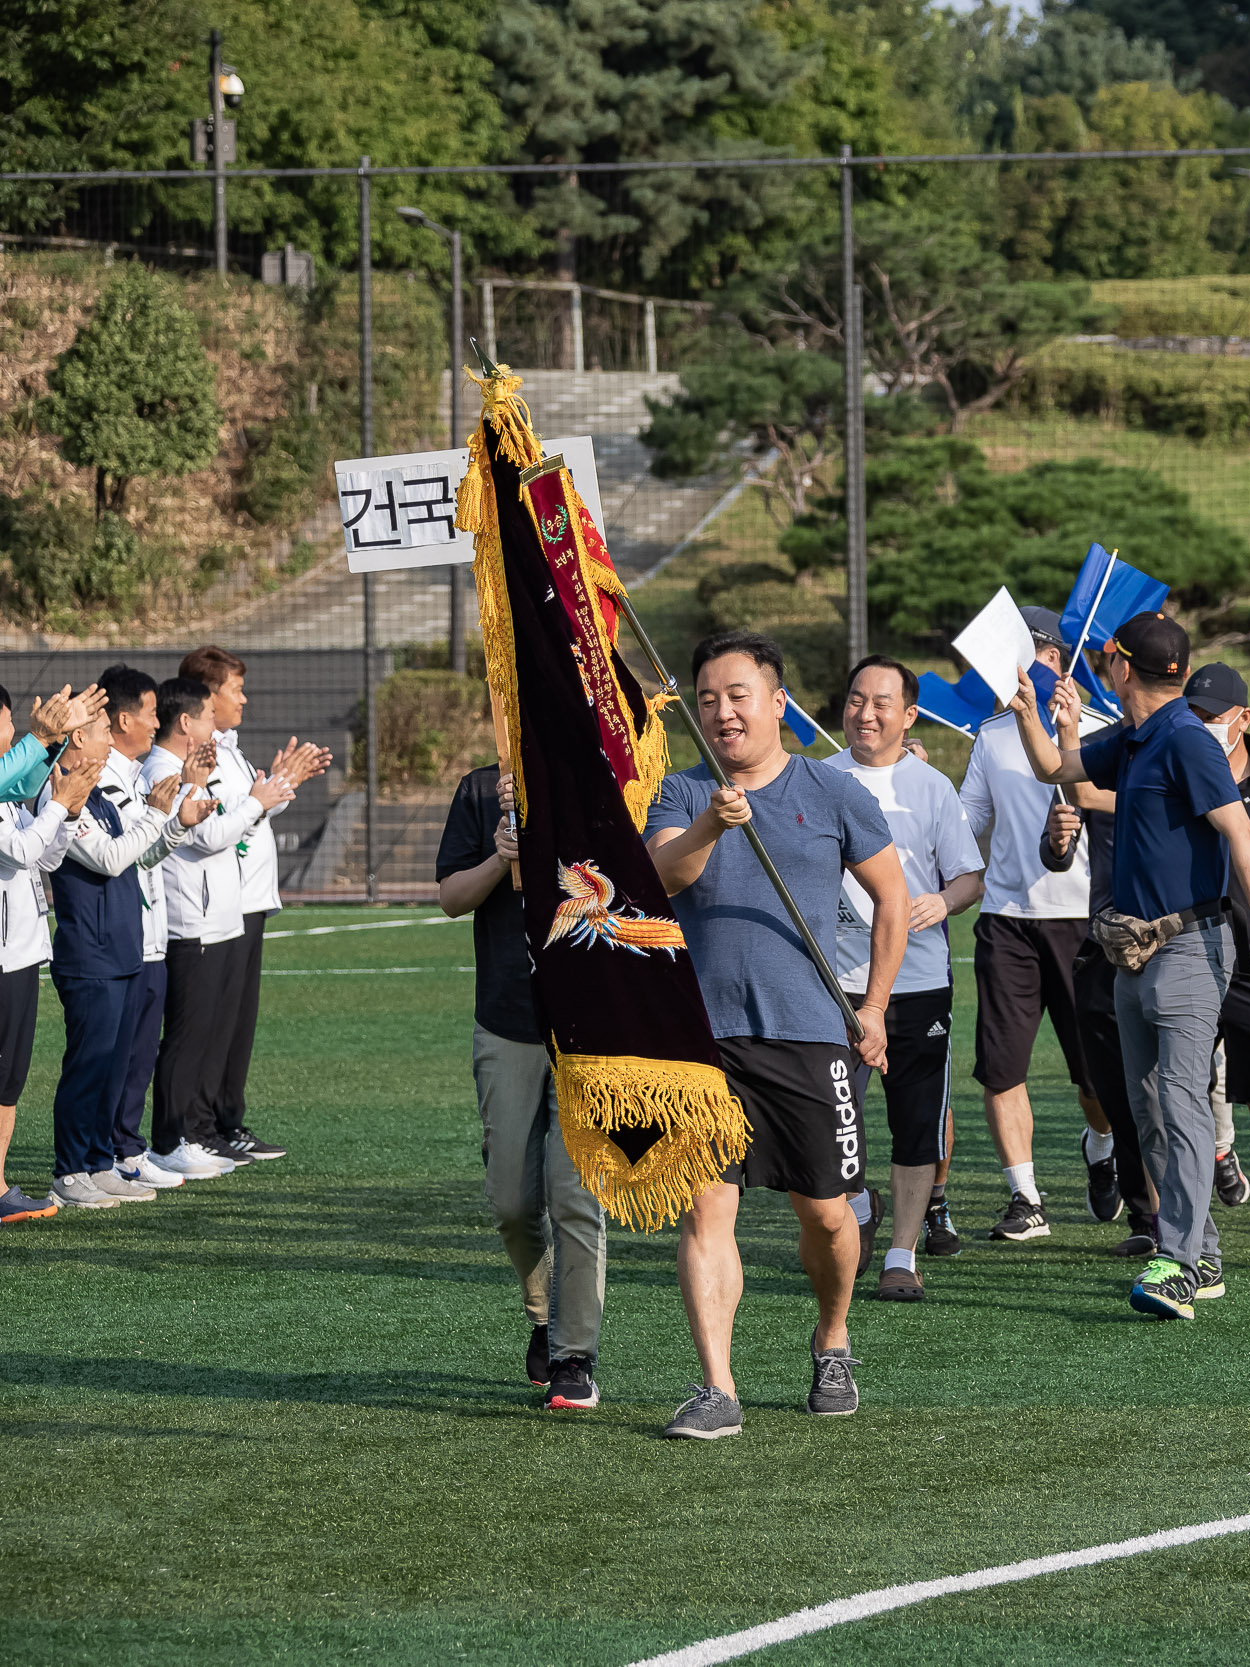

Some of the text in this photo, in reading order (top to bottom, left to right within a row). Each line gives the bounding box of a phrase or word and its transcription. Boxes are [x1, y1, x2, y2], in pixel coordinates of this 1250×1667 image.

[341, 476, 456, 548] 건국
[546, 514, 563, 533] 우승
[830, 1060, 859, 1180] adidas
